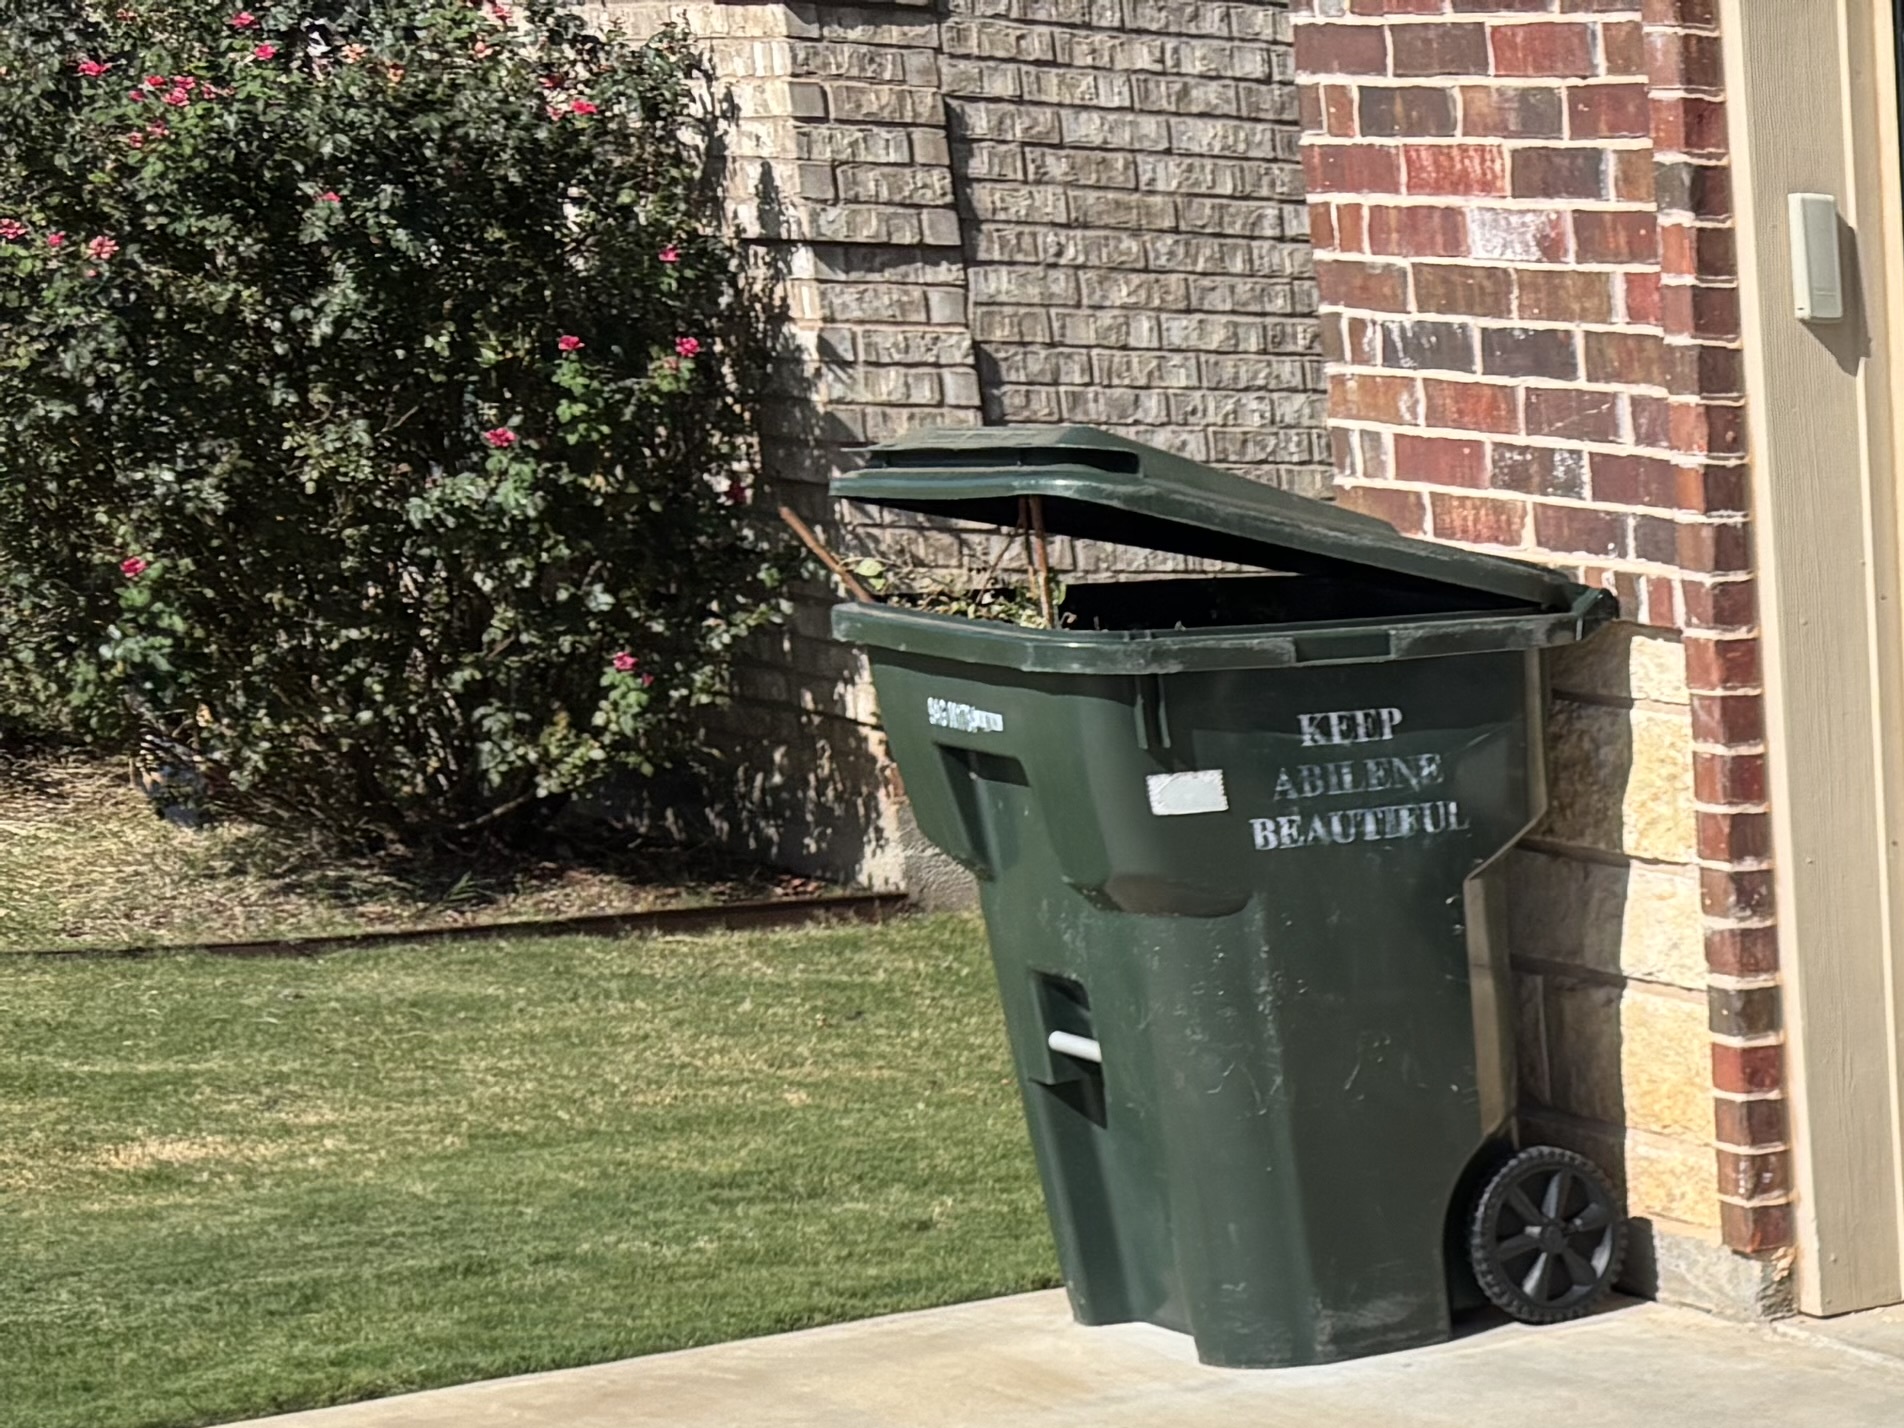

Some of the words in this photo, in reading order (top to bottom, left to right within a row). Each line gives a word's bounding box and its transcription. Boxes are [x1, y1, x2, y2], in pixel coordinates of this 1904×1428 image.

[1297, 708, 1403, 746] KEEP
[1273, 753, 1444, 801] ABILENE
[1249, 801, 1471, 851] BEAUTIFUL
